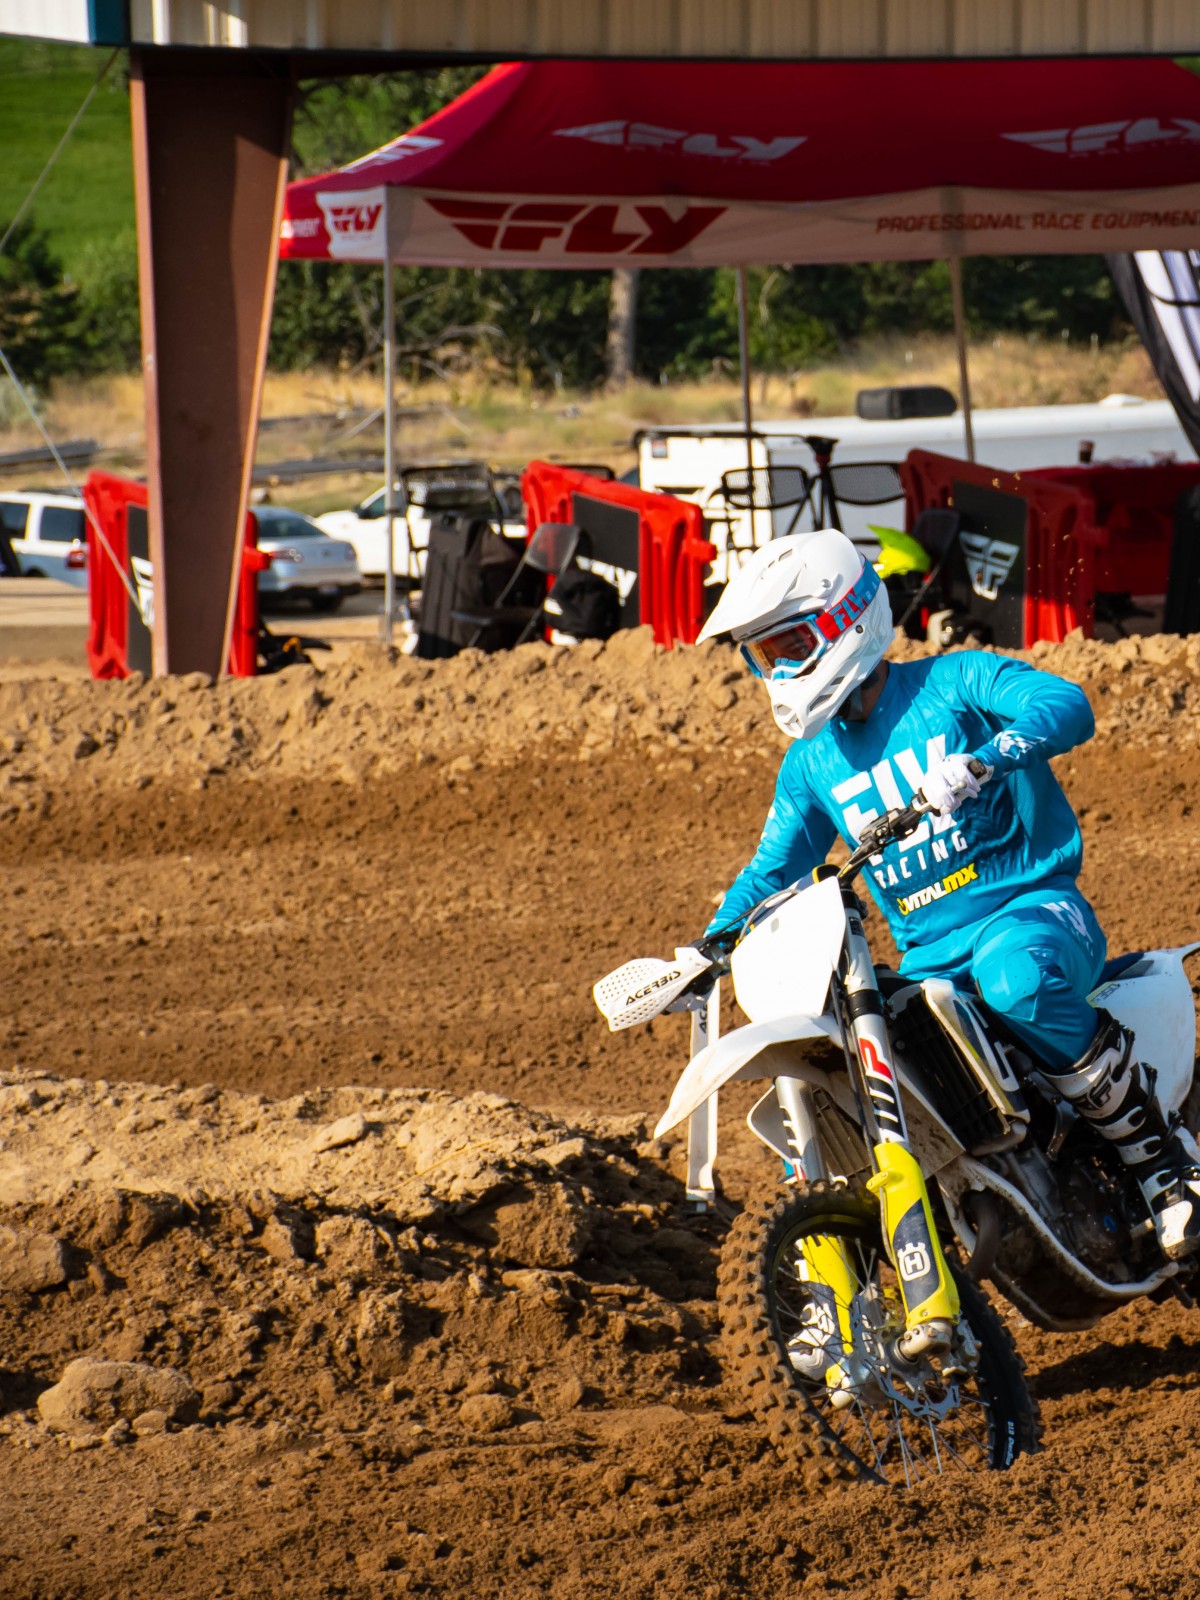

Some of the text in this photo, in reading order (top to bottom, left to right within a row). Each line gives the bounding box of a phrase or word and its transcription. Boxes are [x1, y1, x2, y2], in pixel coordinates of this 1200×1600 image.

[551, 119, 808, 160] FLY
[331, 204, 383, 232] FLY
[424, 198, 728, 254] FLY
[876, 214, 1025, 234] PROFESSIONAL
[1032, 212, 1084, 230] RACE
[829, 585, 870, 630] FLY
[874, 830, 968, 889] RACING
[626, 970, 682, 1006] ACERBIS
